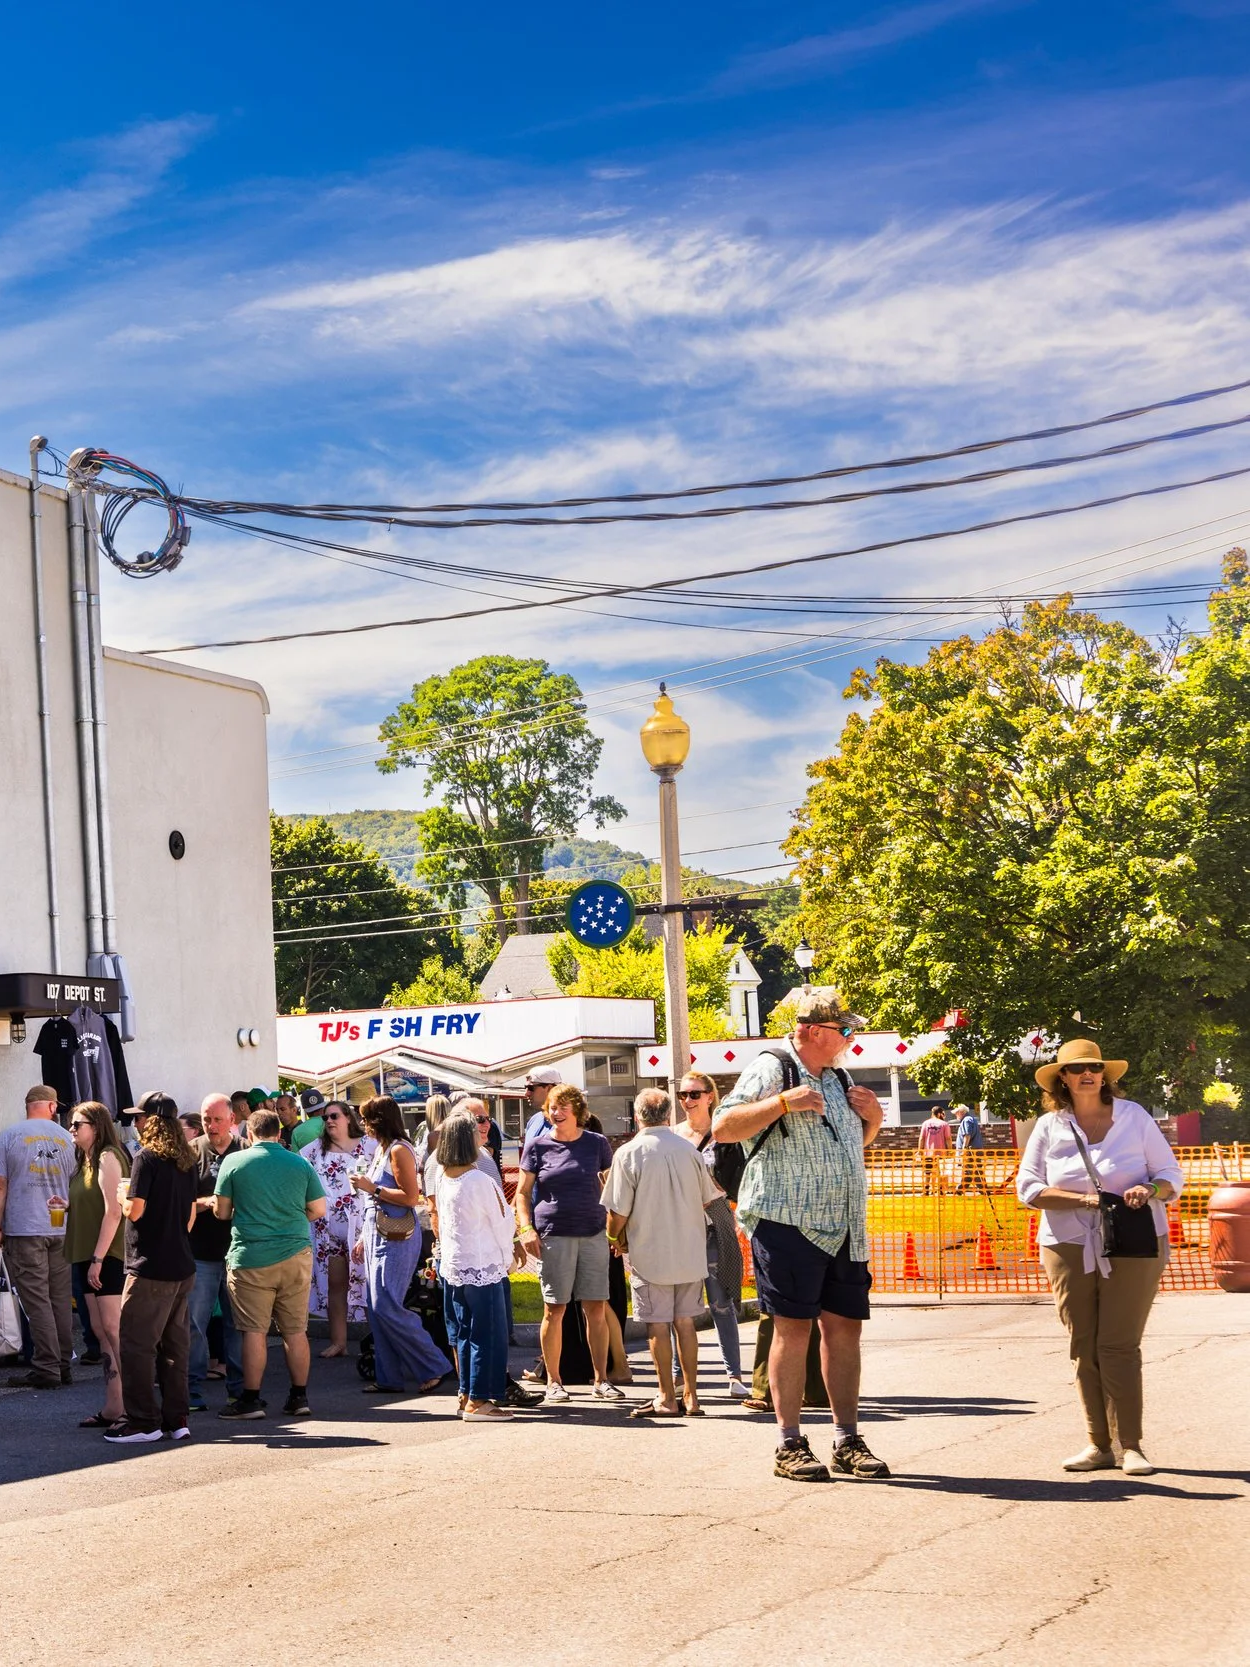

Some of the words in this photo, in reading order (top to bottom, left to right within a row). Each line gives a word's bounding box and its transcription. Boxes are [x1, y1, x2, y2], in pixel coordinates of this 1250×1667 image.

[46, 983, 60, 999] 107
[65, 984, 90, 1001] DEPOT
[94, 987, 106, 1002] ST.
[318, 1021, 360, 1042] TJ's
[431, 1012, 481, 1035] FRY
